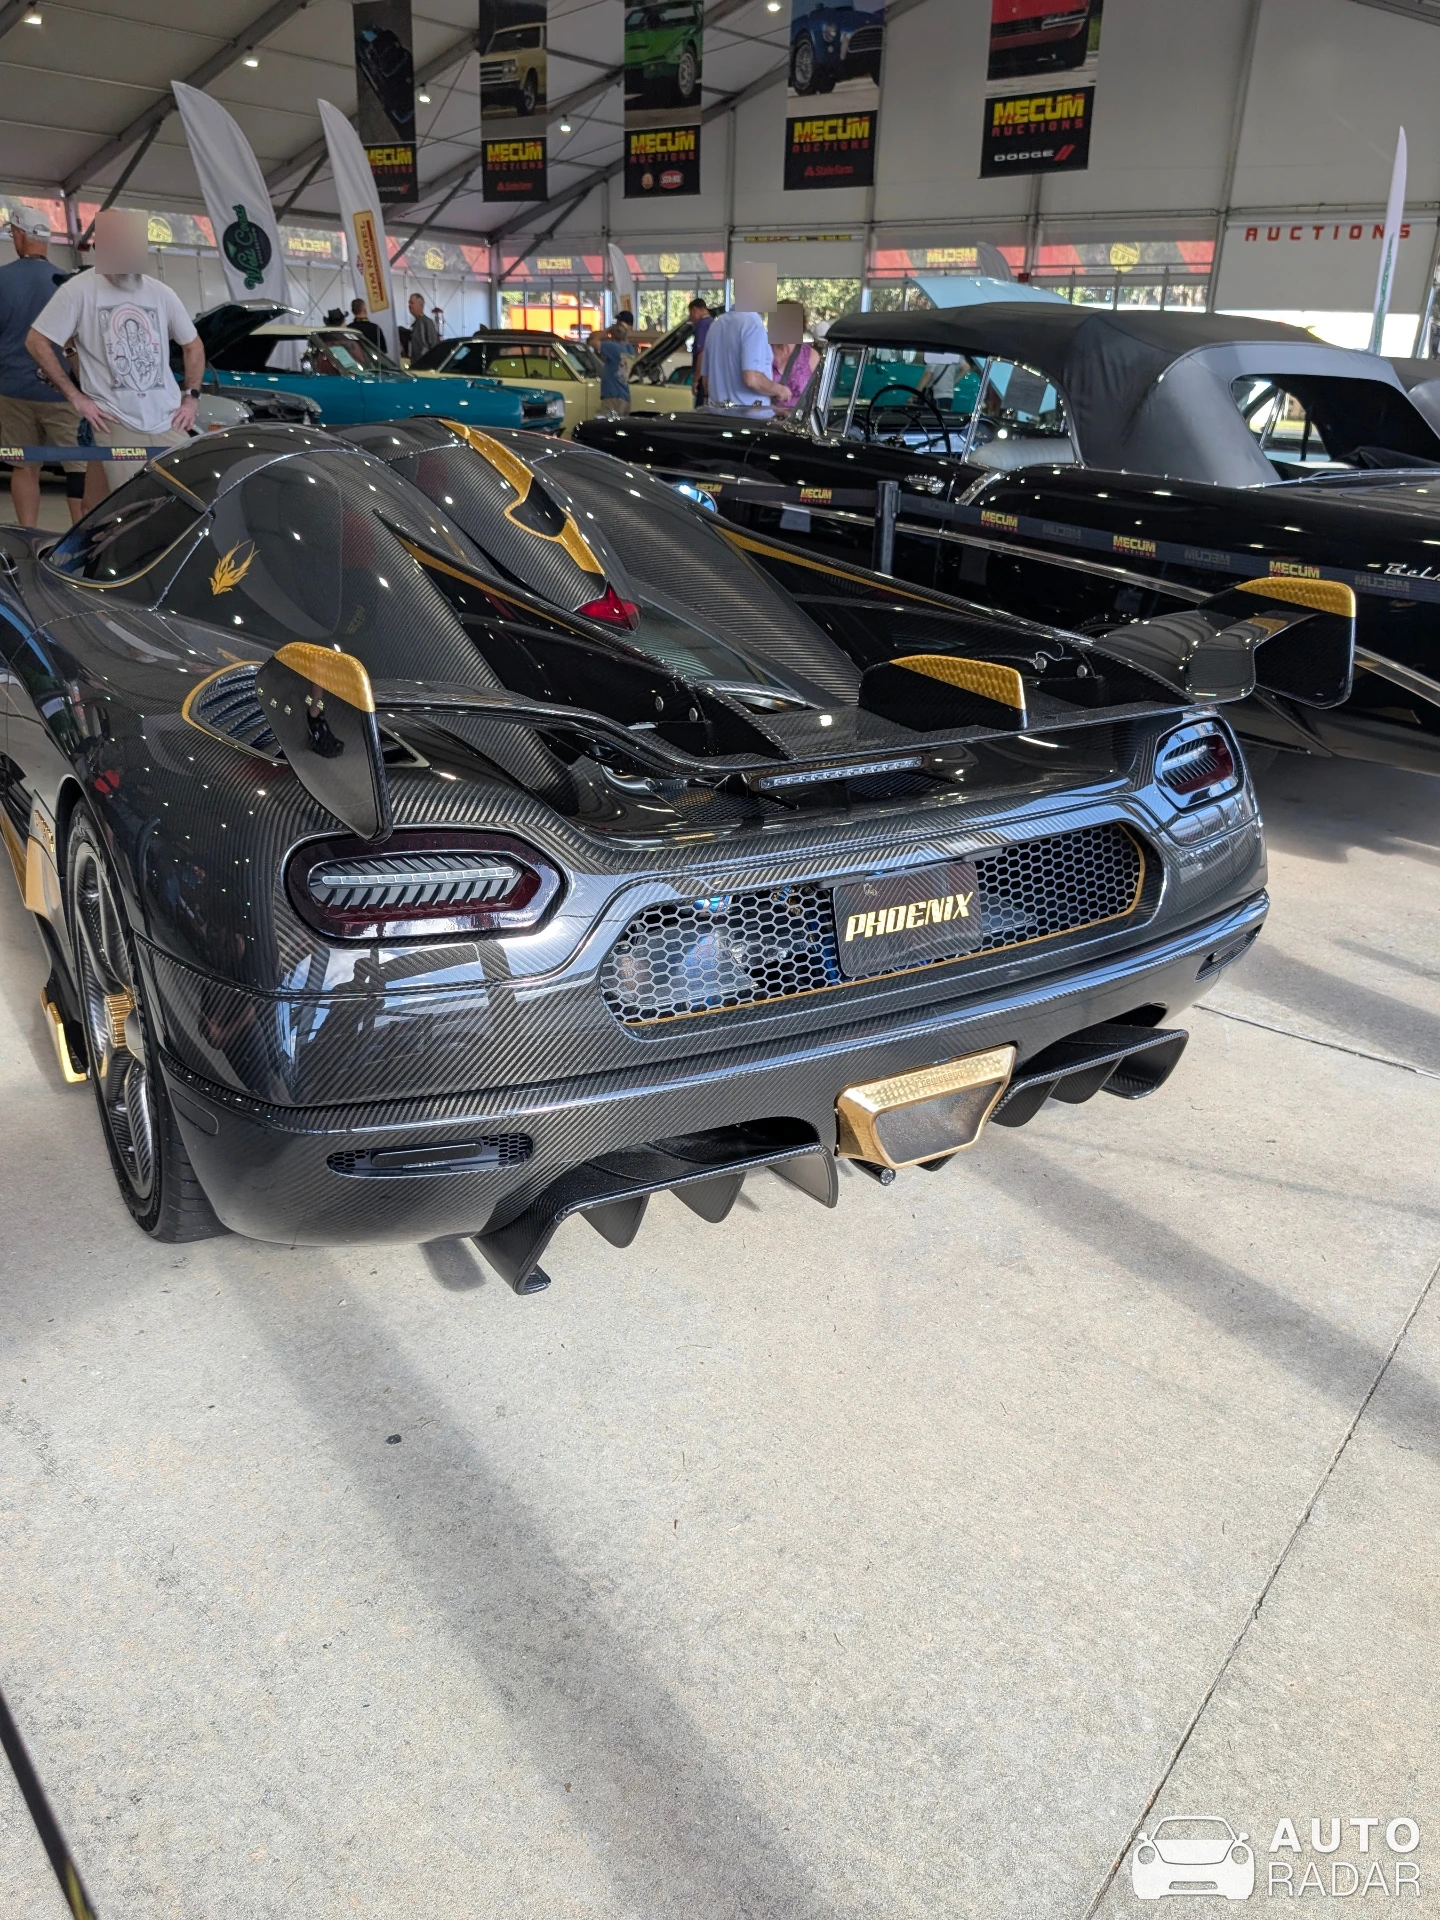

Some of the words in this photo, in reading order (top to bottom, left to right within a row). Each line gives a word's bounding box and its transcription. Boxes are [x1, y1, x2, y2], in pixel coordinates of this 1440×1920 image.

[993, 93, 1085, 126] MECUM
[793, 117, 870, 143] MECUM
[992, 118, 1084, 137] AUCTIONS
[631, 130, 696, 155] MECUM
[792, 139, 869, 153] AUCTIONS
[487, 142, 543, 163] MECUM
[630, 151, 695, 164] AUCTIONS
[994, 149, 1054, 162] DODGE
[486, 161, 543, 172] AUCTIONS
[1245, 224, 1411, 241] AUCTIONS
[111, 447, 147, 457] MECUM
[800, 488, 832, 499] MECUM
[981, 510, 1018, 528] MECUM
[1113, 535, 1156, 553] MECUM
[1269, 560, 1320, 579] MECUM
[845, 892, 973, 942] PHOENIX
